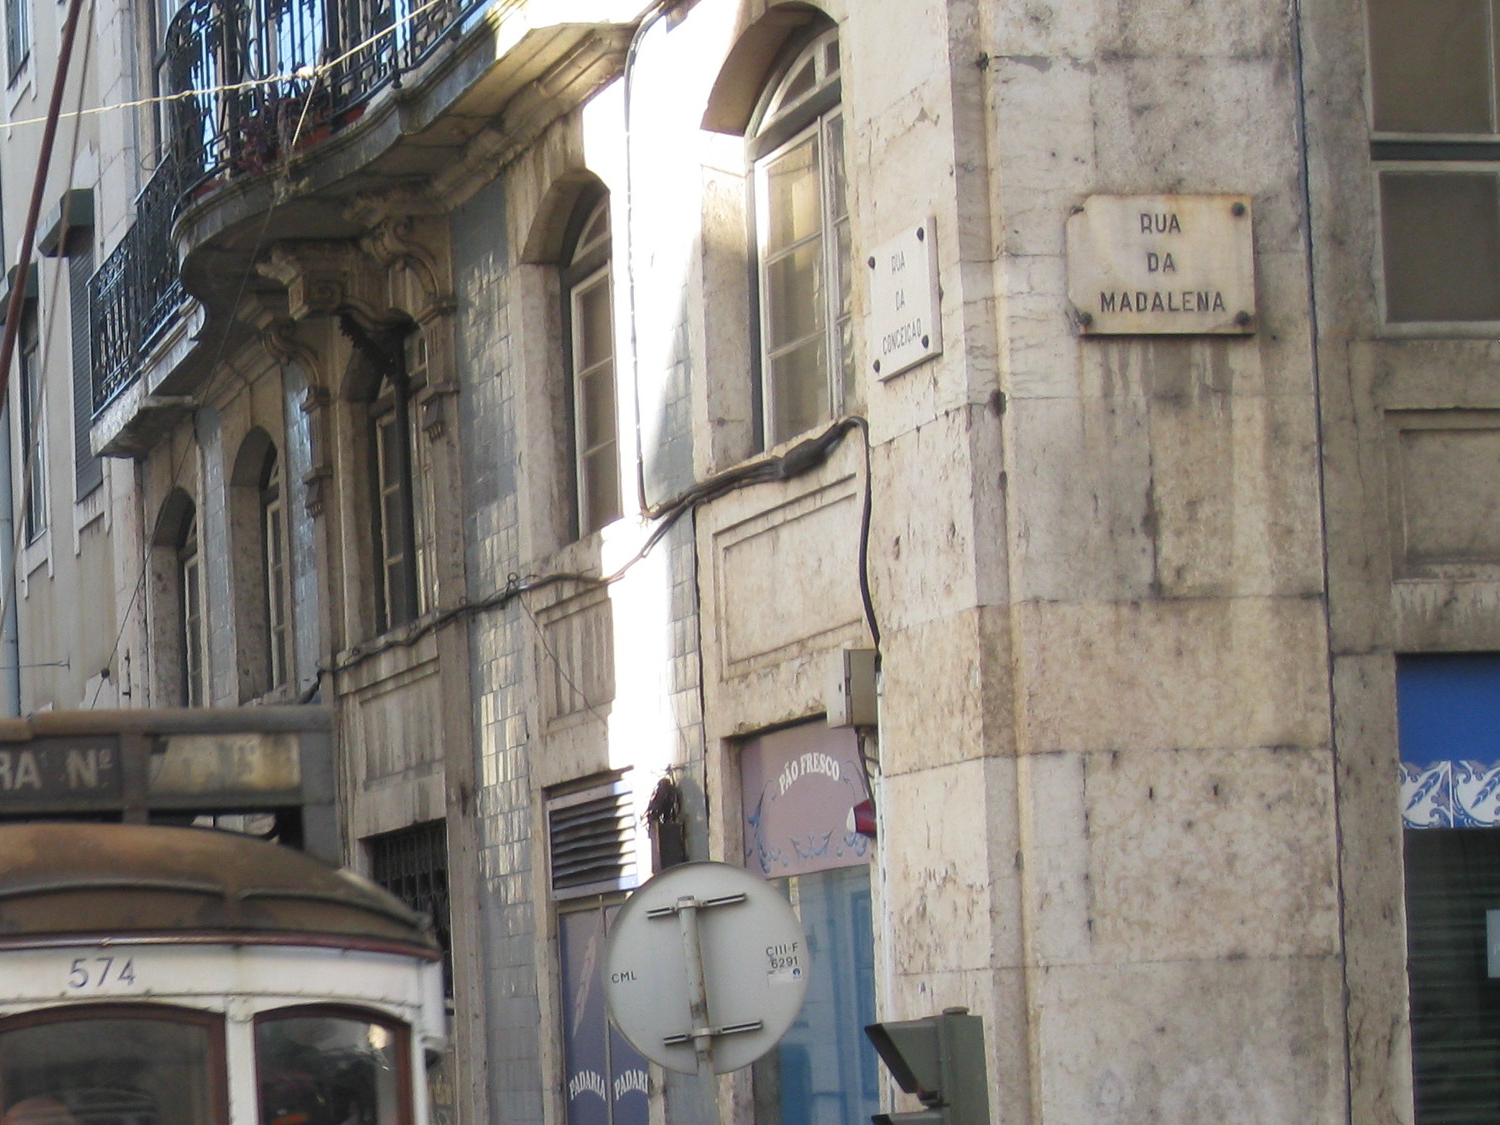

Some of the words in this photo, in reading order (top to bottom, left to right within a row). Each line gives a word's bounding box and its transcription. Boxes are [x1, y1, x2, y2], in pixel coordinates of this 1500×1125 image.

[1140, 213, 1181, 234] RUA
[891, 251, 906, 275] RUA
[1147, 252, 1176, 273] DA
[1101, 291, 1226, 313] MADALENA
[779, 760, 799, 796] PÃO
[800, 752, 839, 781] FRESCO
[68, 957, 136, 989] 574
[771, 956, 798, 969] 6291
[611, 970, 637, 984] CML
[569, 1069, 606, 1102] PADARIA
[614, 1069, 649, 1101] PADARI
